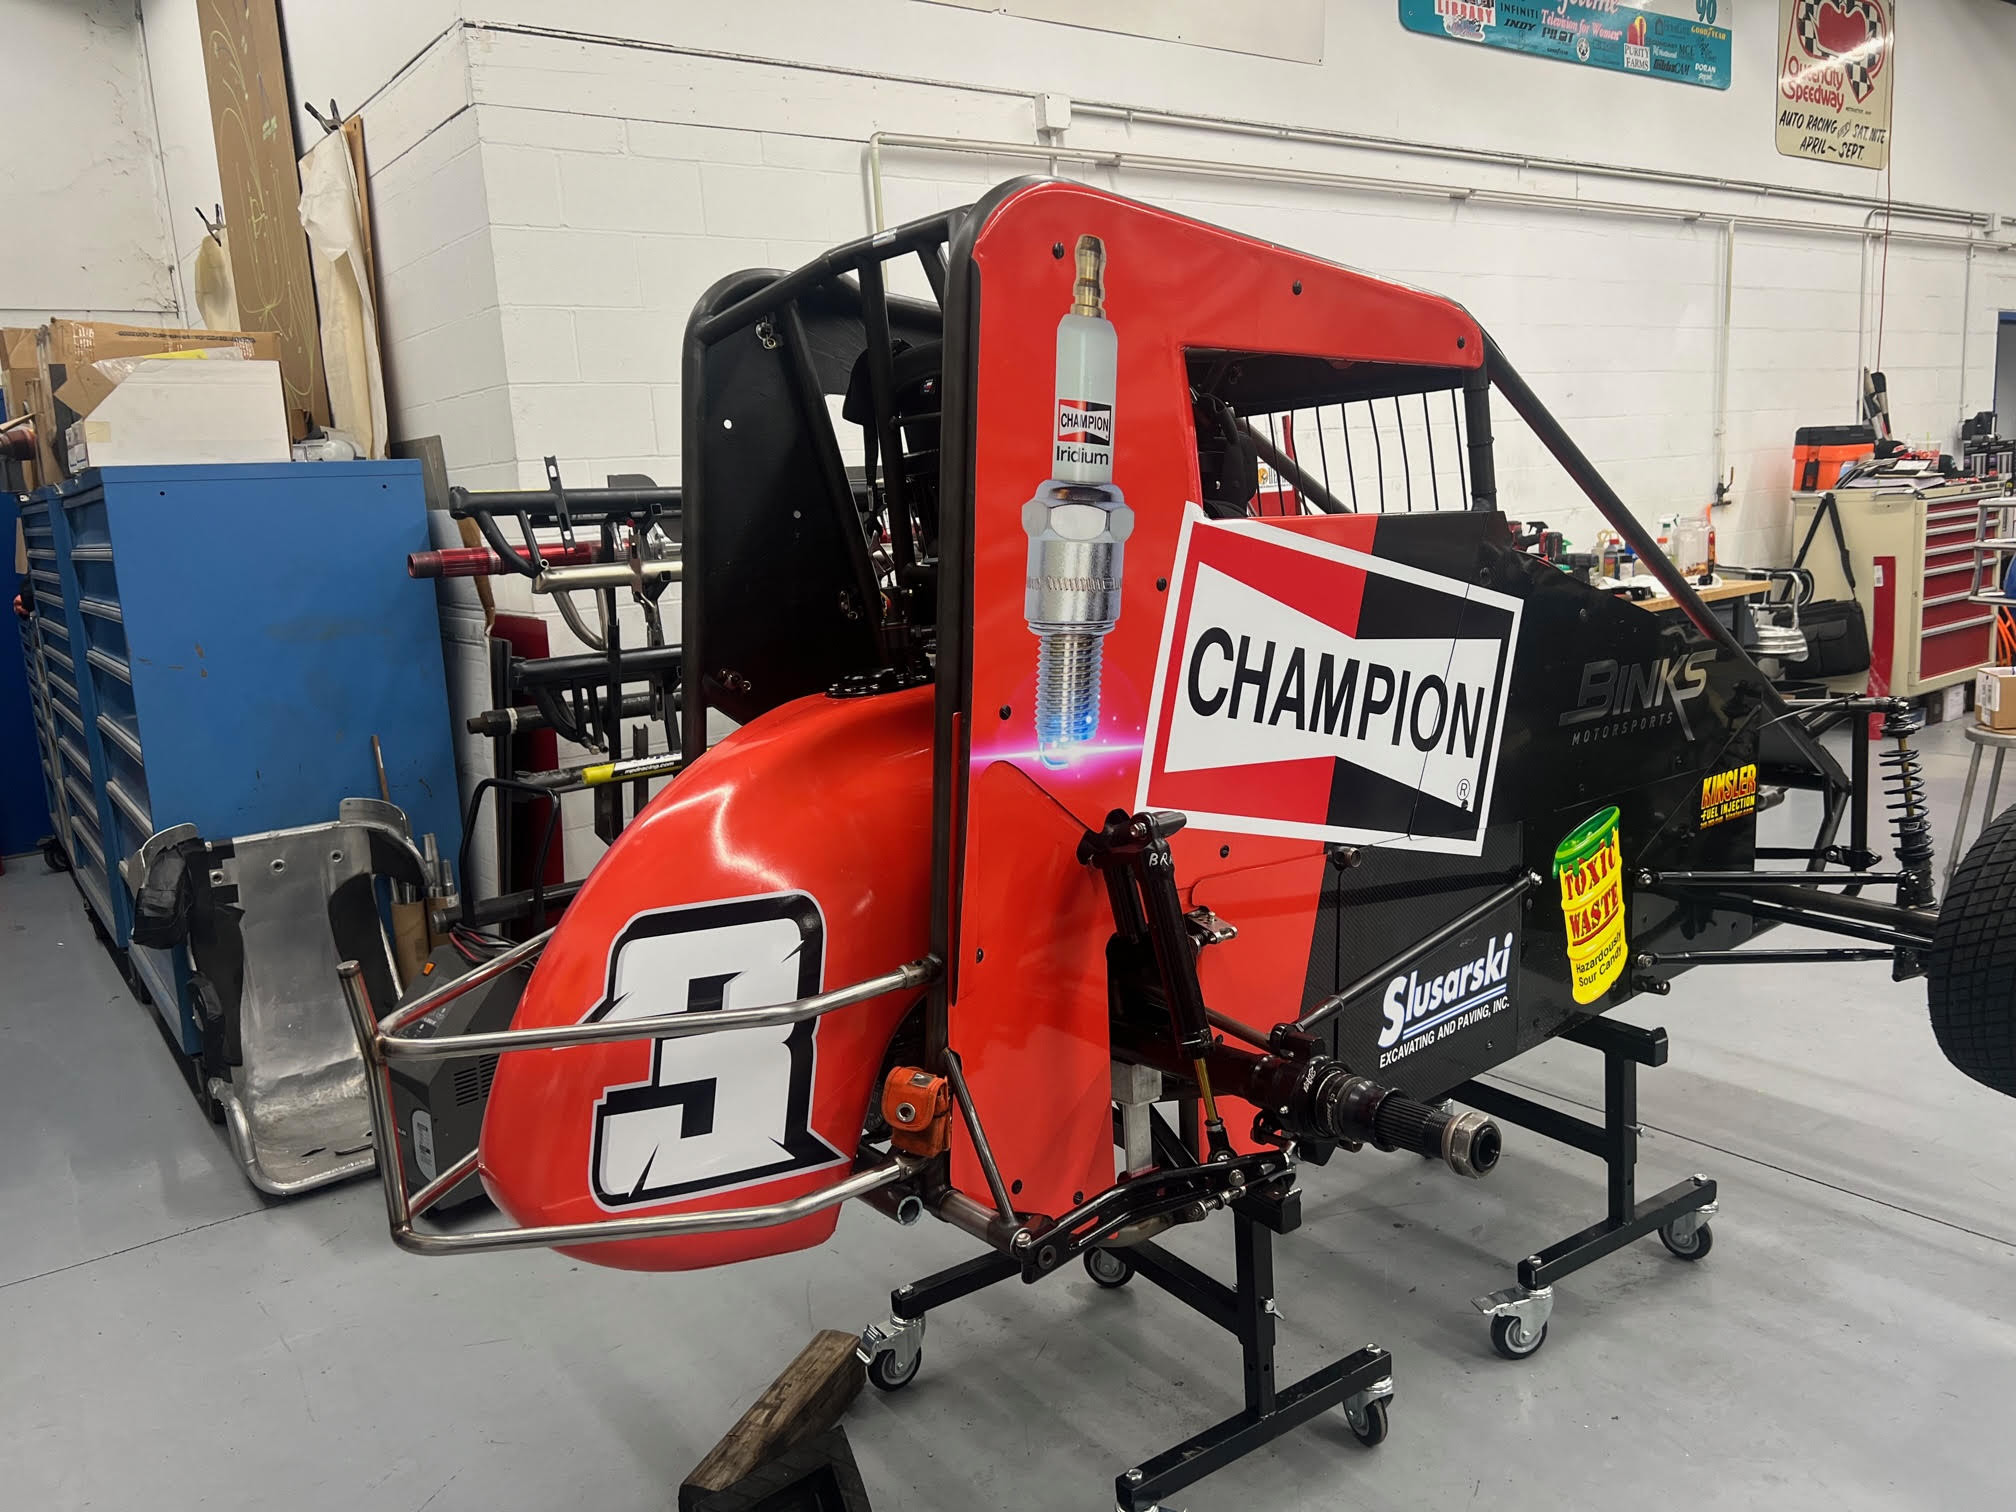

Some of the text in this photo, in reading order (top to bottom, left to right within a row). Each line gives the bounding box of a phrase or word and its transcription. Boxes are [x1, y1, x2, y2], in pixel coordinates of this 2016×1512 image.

[1437, 0, 1492, 23] LIBRARY
[1500, 3, 1539, 19] INFINITI
[1504, 19, 1536, 31] INDY
[1577, 18, 1590, 36] for
[1624, 45, 1650, 58] PURITY
[1626, 57, 1650, 70] FARMS
[1781, 80, 1845, 113] Speedway
[1779, 110, 1805, 129] AUTO
[1806, 114, 1838, 135] RACING
[1800, 136, 1826, 154] APRIL
[1060, 413, 1109, 432] CHAMPION
[1056, 445, 1109, 465] Iridium
[1187, 626, 1485, 759] CHAMPION
[1559, 648, 1717, 741] BINKS
[1572, 711, 1674, 746] MOTORSPORTS
[1701, 764, 1756, 810] KINSLER
[1720, 795, 1755, 815] INJECTION
[1568, 881, 1619, 939] WASTE
[1576, 931, 1622, 974] Hazardously
[1578, 944, 1622, 987] Sour Candy
[1378, 931, 1513, 1048] Slusarski
[1380, 995, 1510, 1069] EXCAVATING AND PAVING, INC.
